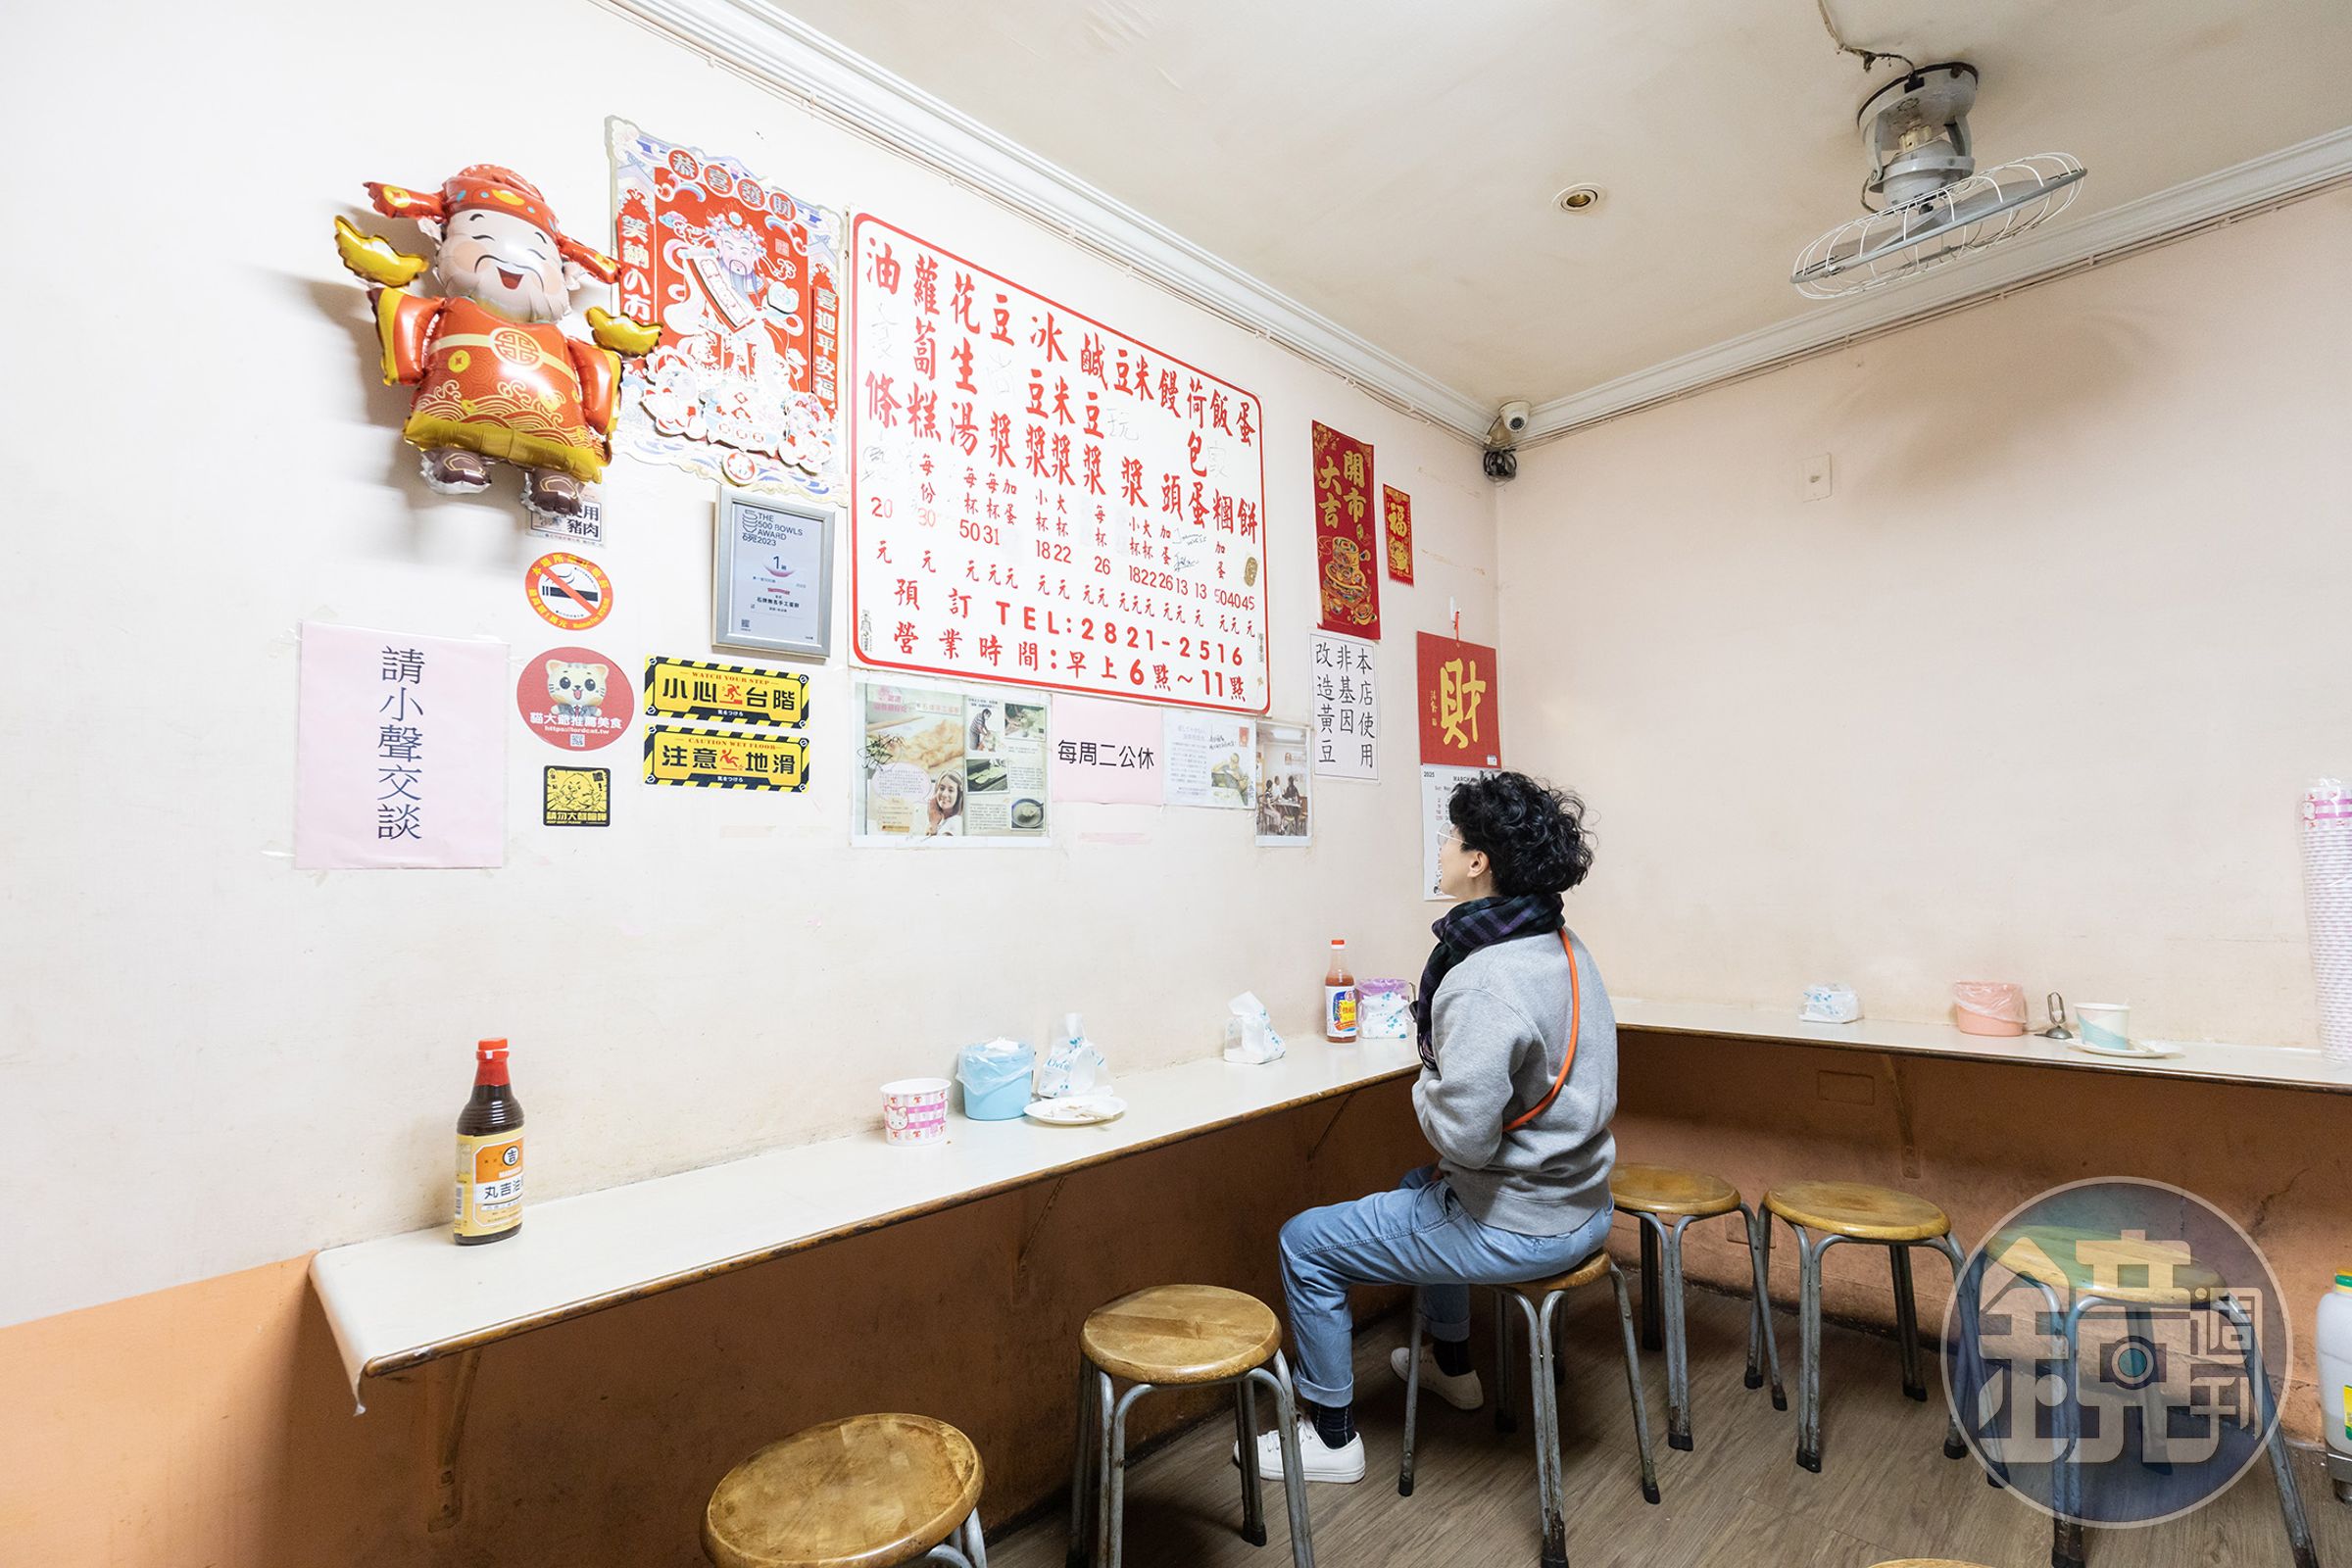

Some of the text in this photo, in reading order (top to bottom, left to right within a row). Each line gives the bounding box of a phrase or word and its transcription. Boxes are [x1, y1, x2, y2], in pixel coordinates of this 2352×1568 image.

[671, 152, 792, 219] 恭喜發財
[906, 253, 941, 443] 蘿蔔糕
[1030, 312, 1068, 363] 冰
[950, 270, 980, 456] 花生湯
[1187, 376, 1209, 529] 荷包蛋
[919, 453, 936, 504] 每份
[963, 466, 978, 515] 每杯
[986, 472, 1001, 519] 每杯
[759, 513, 774, 522] THE
[1003, 479, 1017, 525] 加蛋
[1035, 488, 1049, 532] 小杯
[1056, 494, 1069, 537] 大杯
[1388, 501, 1407, 537] 福
[567, 518, 599, 538] 豬肉
[758, 529, 787, 541] AWARD
[758, 537, 776, 547] 2023
[759, 520, 803, 537] 500 BOWLS
[1095, 505, 1107, 548] 每杯
[1129, 516, 1141, 556] 小杯
[1142, 519, 1153, 560] 大杯
[1160, 525, 1171, 565] 加蛋
[1095, 556, 1110, 575] 26
[1196, 582, 1206, 600] 13
[662, 678, 795, 710] 小心 台階
[724, 674, 748, 683] YOUR
[1337, 644, 1355, 735] 非基因
[530, 711, 622, 730] 貓大爺推薦美食
[1315, 642, 1337, 763] 改造黃豆
[1356, 648, 1376, 769] 本店使用
[1440, 658, 1487, 750] 財
[377, 646, 425, 840] 請小聲交談
[662, 745, 795, 775] 注意 地滑
[1057, 739, 1154, 769] 每周二公休
[508, 1150, 516, 1163] 吉
